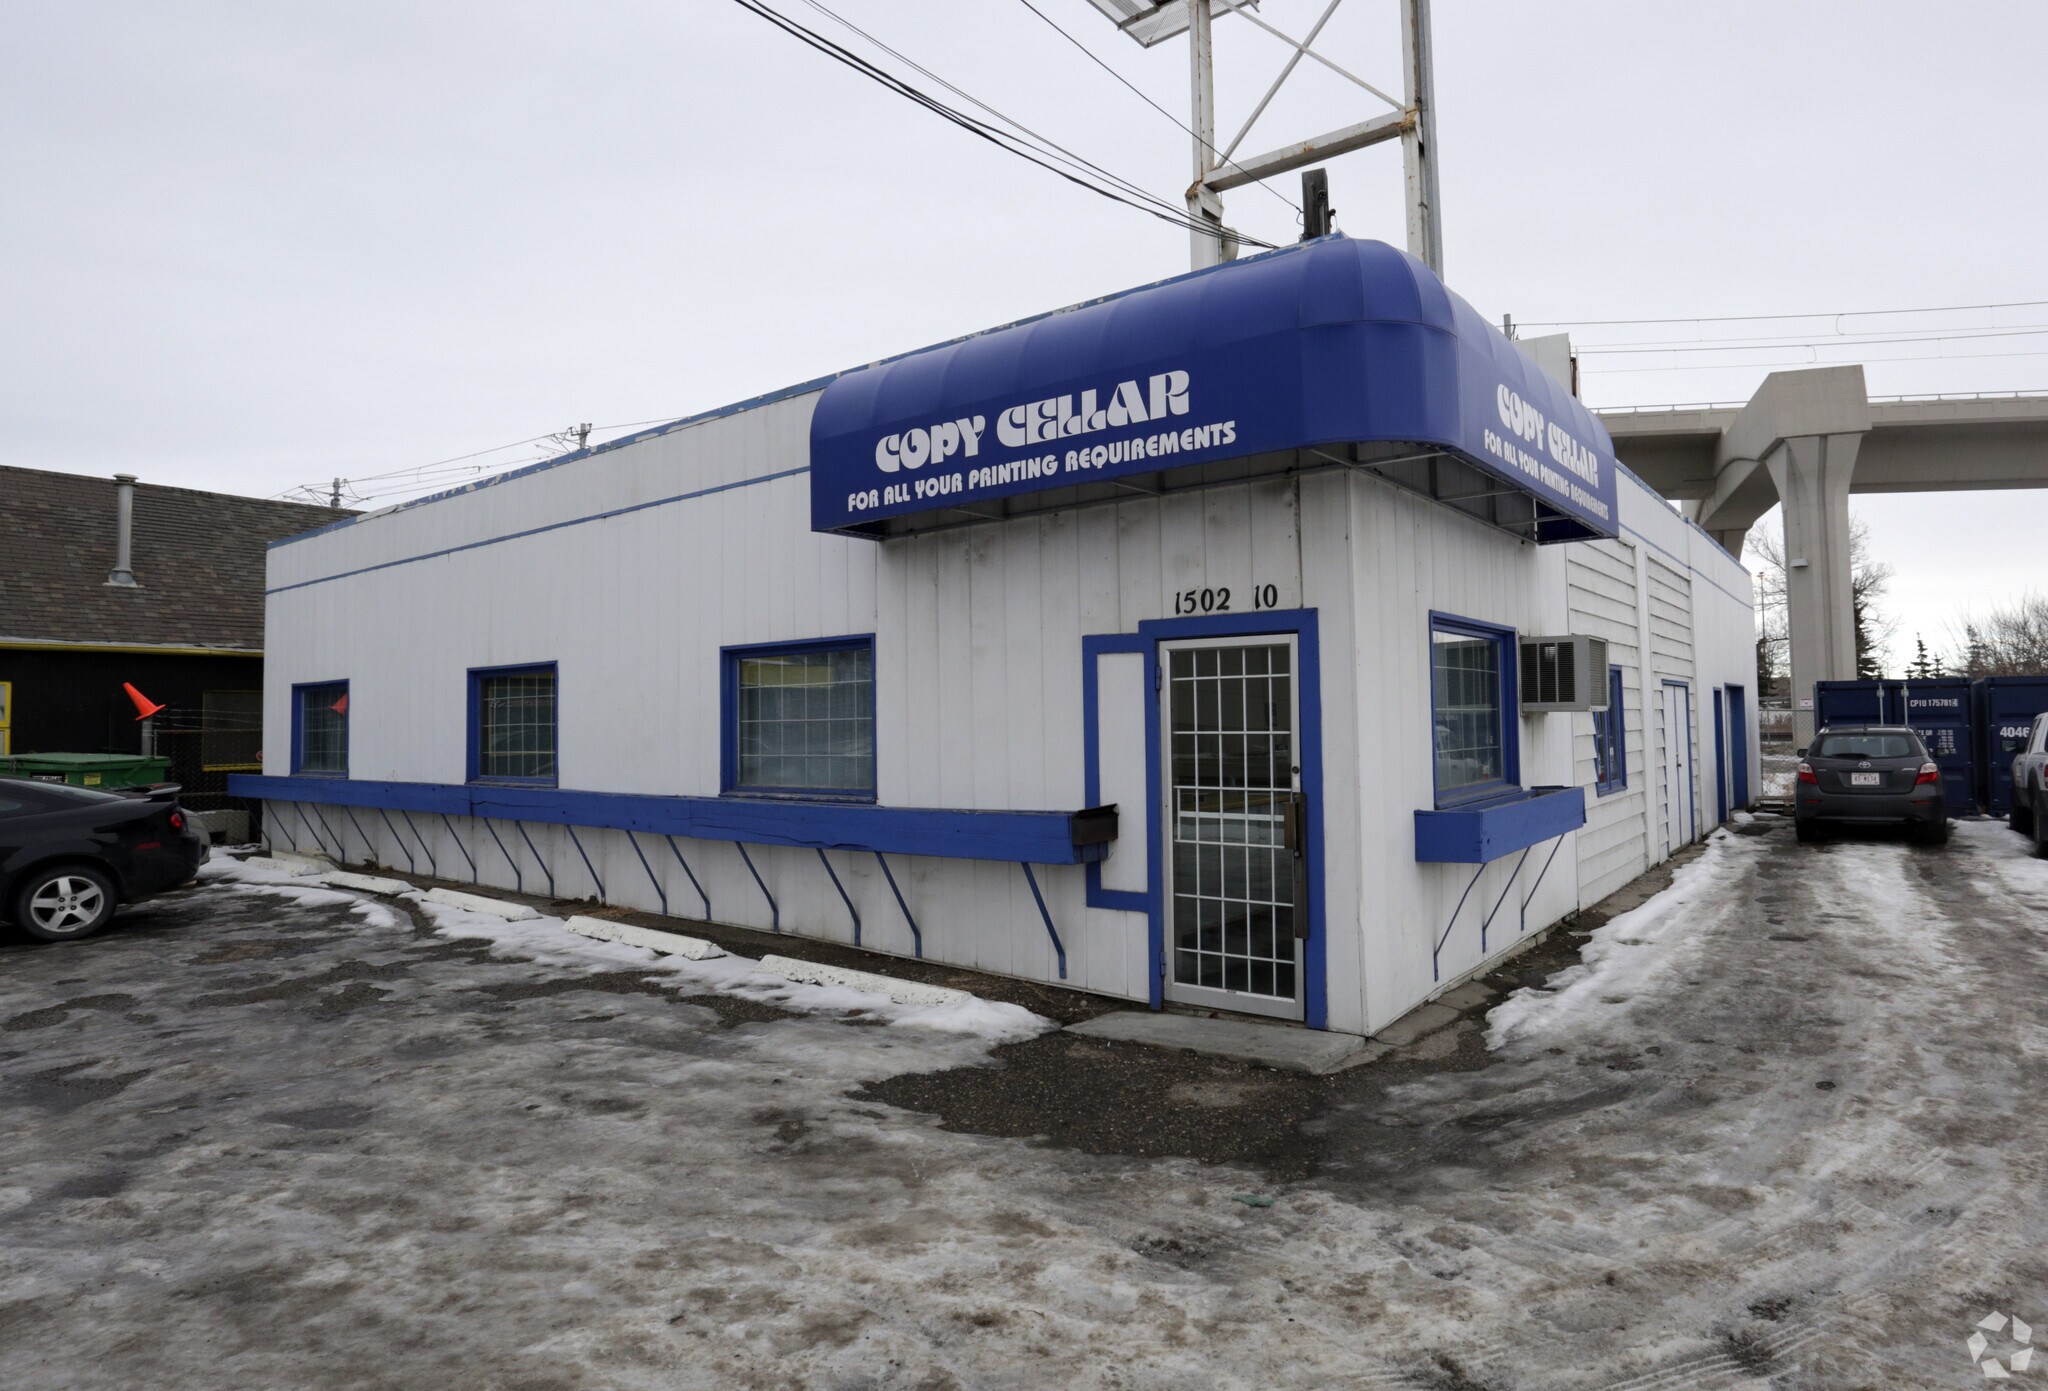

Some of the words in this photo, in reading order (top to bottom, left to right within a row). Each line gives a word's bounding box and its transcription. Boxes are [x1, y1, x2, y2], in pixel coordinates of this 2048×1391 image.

[848, 490, 879, 512] FOR
[884, 480, 911, 506] ALL
[914, 472, 962, 499] YOUR
[969, 455, 1059, 490] PRINTING
[1065, 420, 1237, 473] REQUIREMENTS
[876, 415, 986, 473] COPY
[996, 369, 1190, 448] CELLAR
[1497, 384, 1544, 451] COPY
[1548, 422, 1599, 489] CELLAR
[1484, 429, 1503, 458] FOR
[1503, 441, 1518, 467] ALL
[1518, 449, 1539, 480] YOUR
[1540, 464, 1570, 497] PRINTING
[1570, 483, 1609, 521] REQUIREMENTS
[1175, 587, 1231, 615] 1502
[1254, 584, 1278, 610] 10
